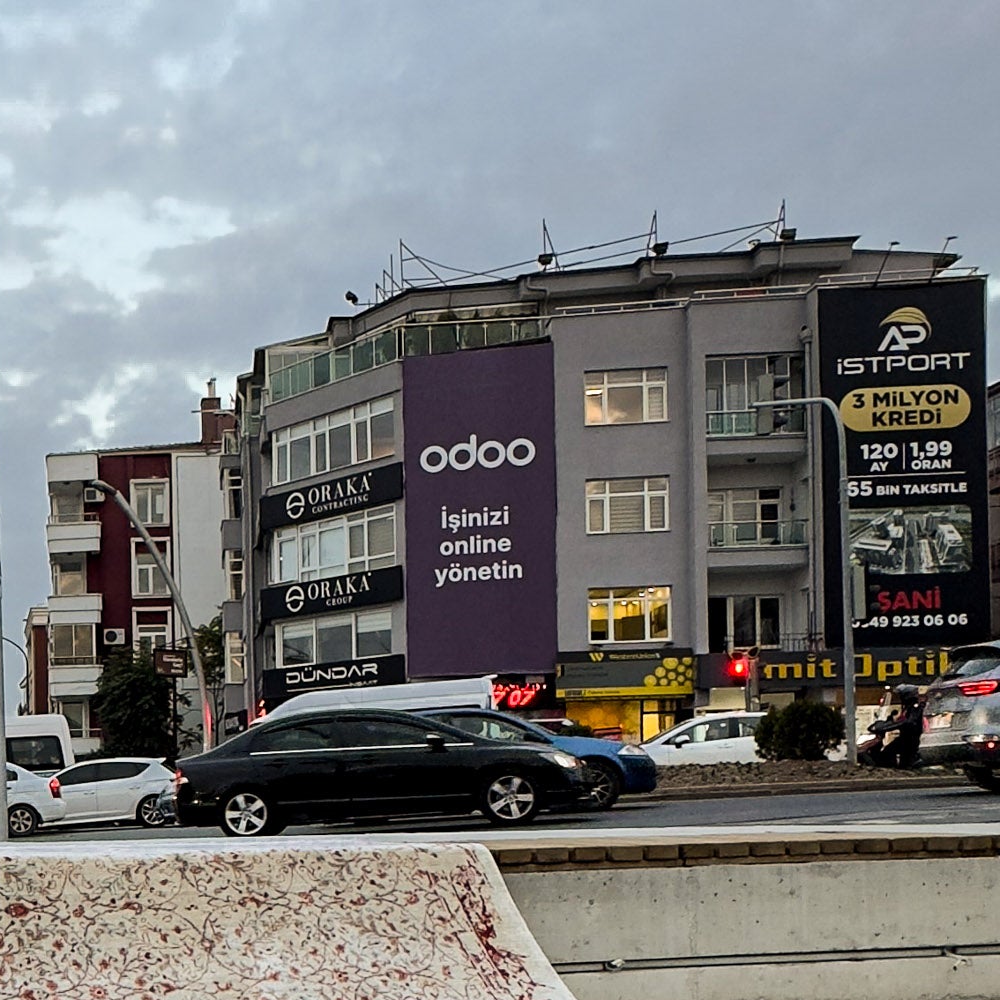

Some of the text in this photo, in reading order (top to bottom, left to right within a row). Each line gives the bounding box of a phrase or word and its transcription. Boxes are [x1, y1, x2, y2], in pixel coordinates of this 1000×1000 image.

[852, 393, 866, 409] 3
[420, 434, 536, 473] odoo
[860, 441, 953, 460] 120 1,99
[870, 459, 952, 472] AY ORAN
[308, 475, 371, 506] ORAKA
[441, 506, 510, 533] İşinizi
[440, 535, 511, 556] online
[434, 560, 523, 587] yönetin
[308, 574, 370, 601] ORAKA
[892, 615, 920, 628] 923
[923, 614, 945, 627] 06
[947, 613, 969, 626] 06
[286, 662, 379, 684] DÜNDAR
